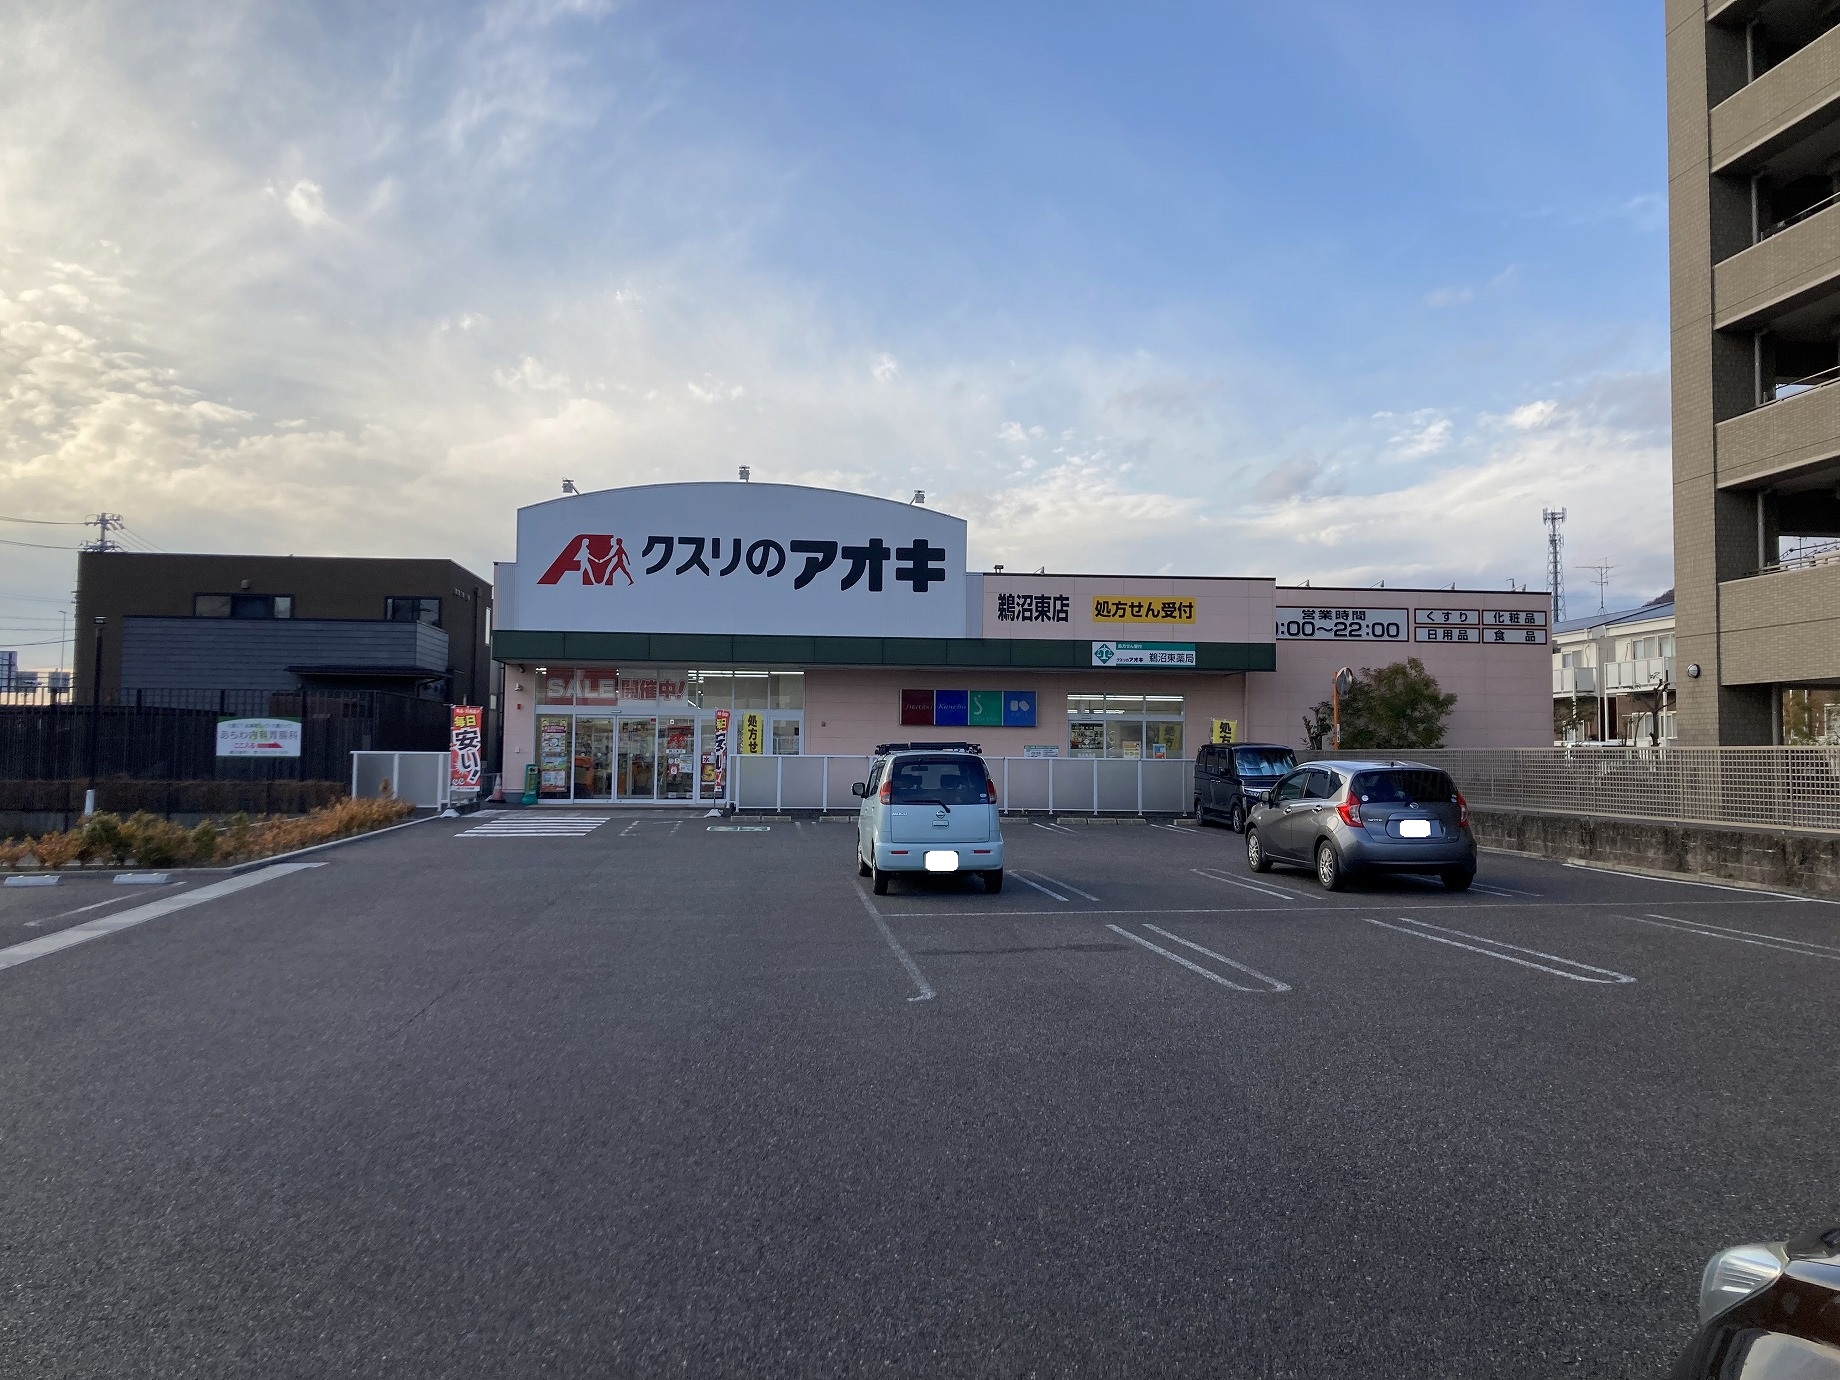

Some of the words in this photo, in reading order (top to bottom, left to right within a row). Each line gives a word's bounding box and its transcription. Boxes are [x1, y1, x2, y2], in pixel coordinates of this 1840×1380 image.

[641, 535, 946, 592] クスリのアオキ
[997, 593, 1070, 622] 鵜沼東店
[1094, 600, 1194, 619] 処方せん受付
[1302, 609, 1366, 621] 営業時間
[1426, 611, 1469, 622] くすり
[1493, 611, 1536, 624] 化粧品
[1276, 621, 1400, 638] :00~22:00
[1427, 629, 1469, 641] 日用品
[1148, 652, 1194, 664] 鵜沼東薬局
[548, 678, 616, 698] SALE
[453, 715, 477, 728] 毎日
